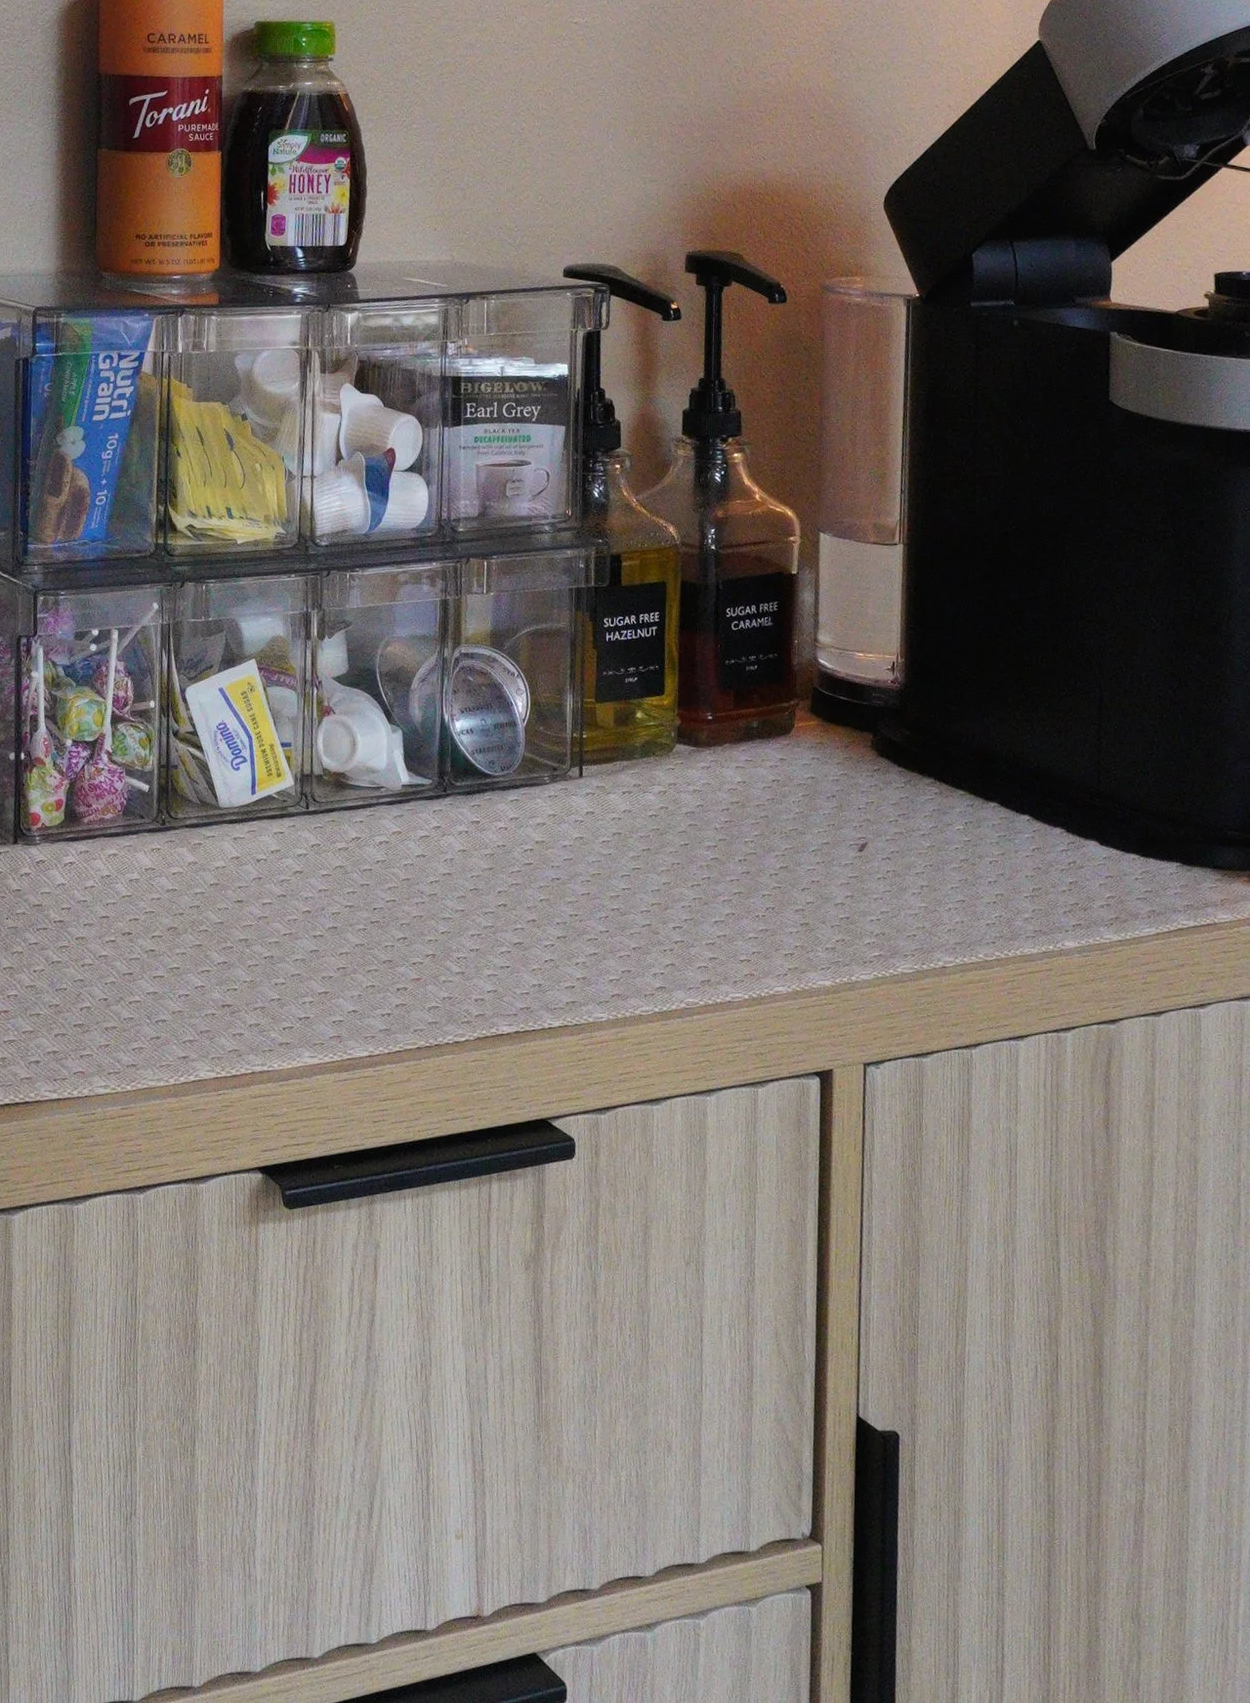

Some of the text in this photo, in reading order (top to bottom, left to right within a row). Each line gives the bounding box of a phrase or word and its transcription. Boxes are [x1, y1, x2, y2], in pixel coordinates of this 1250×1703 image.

[147, 33, 210, 44] CARAMEL
[129, 88, 209, 139] Torani
[178, 123, 219, 132] PUREMADE
[188, 133, 214, 141] SAUCE
[320, 134, 347, 143] ORGANIC
[288, 174, 331, 194] HONEY
[92, 352, 118, 422] Grain
[109, 351, 140, 421] Nutri
[460, 381, 546, 394] BIGELOW
[465, 402, 541, 422] Earl Grey
[474, 435, 532, 443] DECAFFEINATED
[726, 601, 778, 618] SUGAR FREE
[603, 611, 660, 628] SUGAR FREE
[731, 616, 774, 631] CARAMEL
[605, 626, 658, 642] HAZELNUT
[215, 721, 249, 772] Domino
